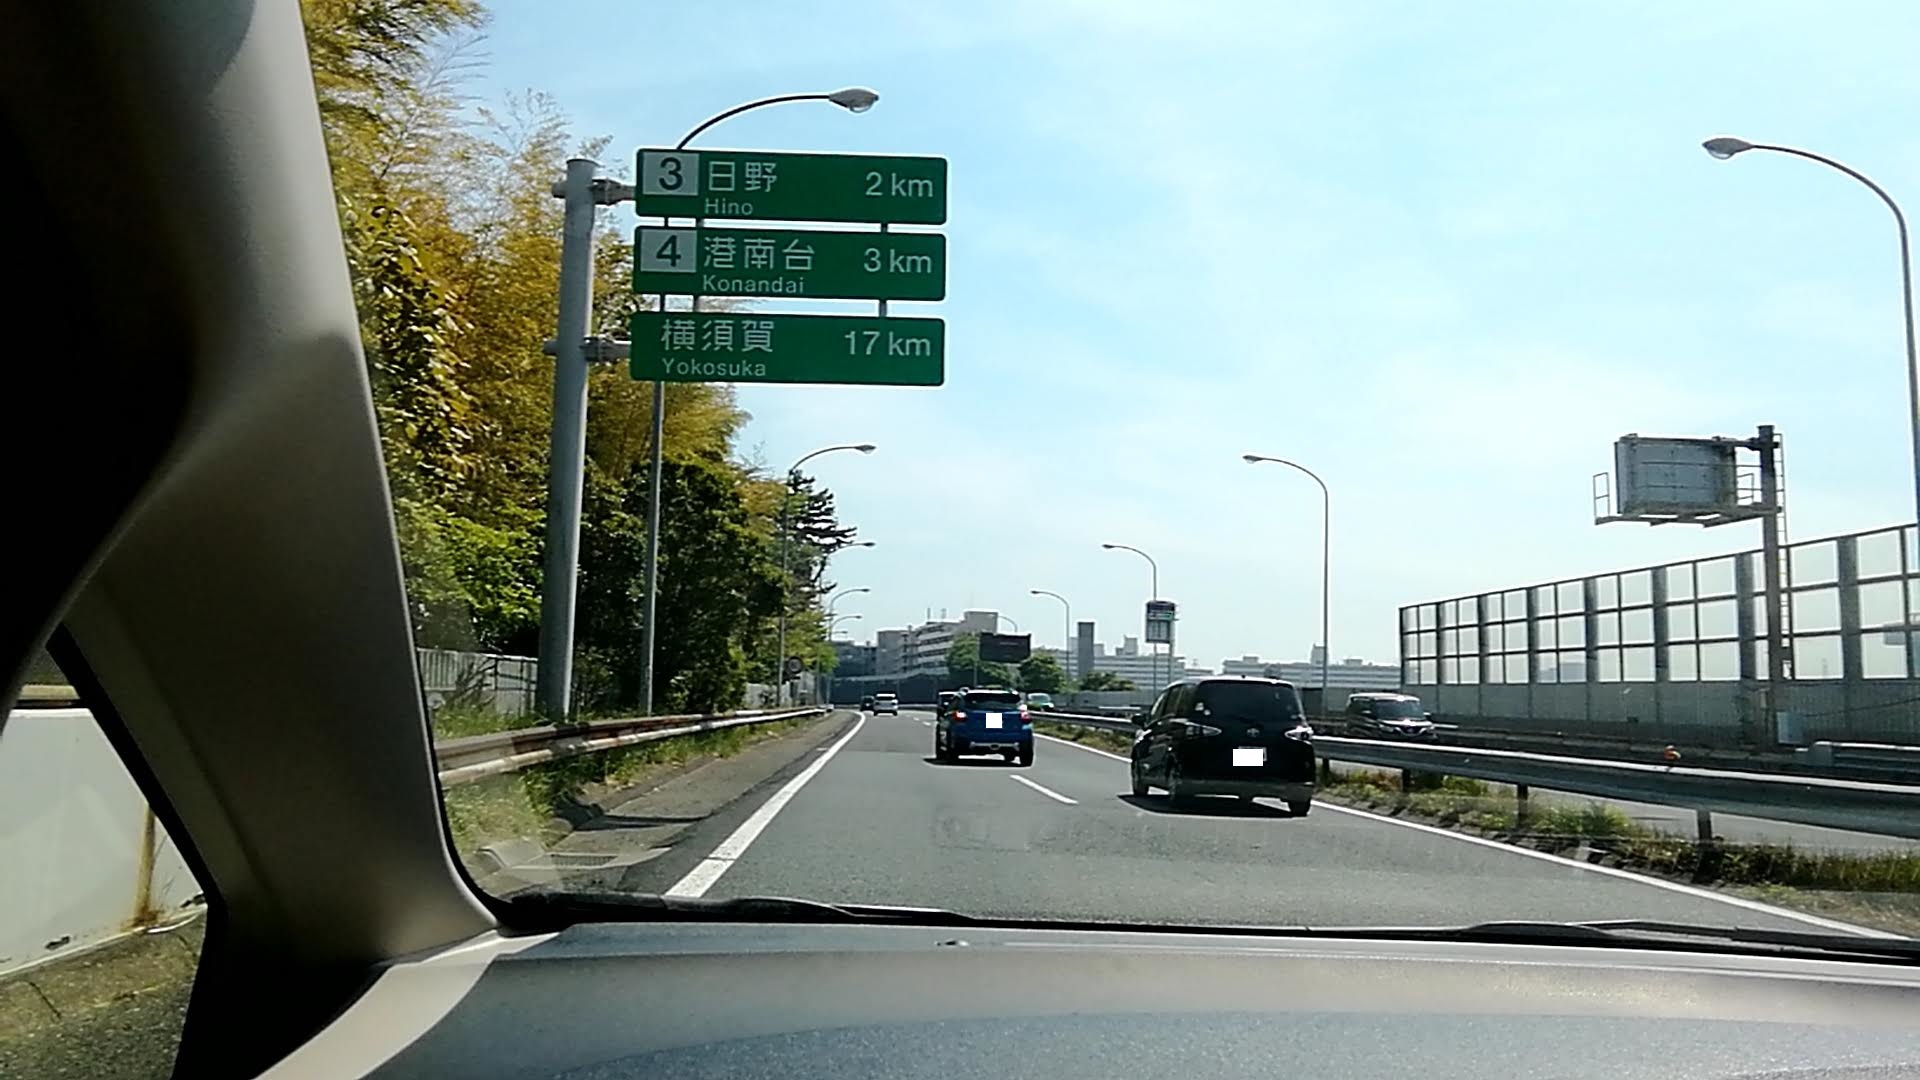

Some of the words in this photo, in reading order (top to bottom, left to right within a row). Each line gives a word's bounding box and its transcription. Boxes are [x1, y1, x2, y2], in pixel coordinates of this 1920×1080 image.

[659, 157, 683, 191] 3
[708, 161, 778, 193] 日野
[865, 172, 884, 197] 2
[892, 173, 933, 198] km
[705, 198, 754, 216] Hino
[656, 234, 681, 267] 4
[703, 236, 815, 271] 港南台
[863, 248, 882, 272] 3
[890, 249, 932, 273] km
[703, 275, 804, 294] Konandai
[661, 319, 774, 353] 横須賀
[845, 331, 881, 356] 17
[889, 332, 931, 356] km
[663, 358, 766, 377] Yokosuka
